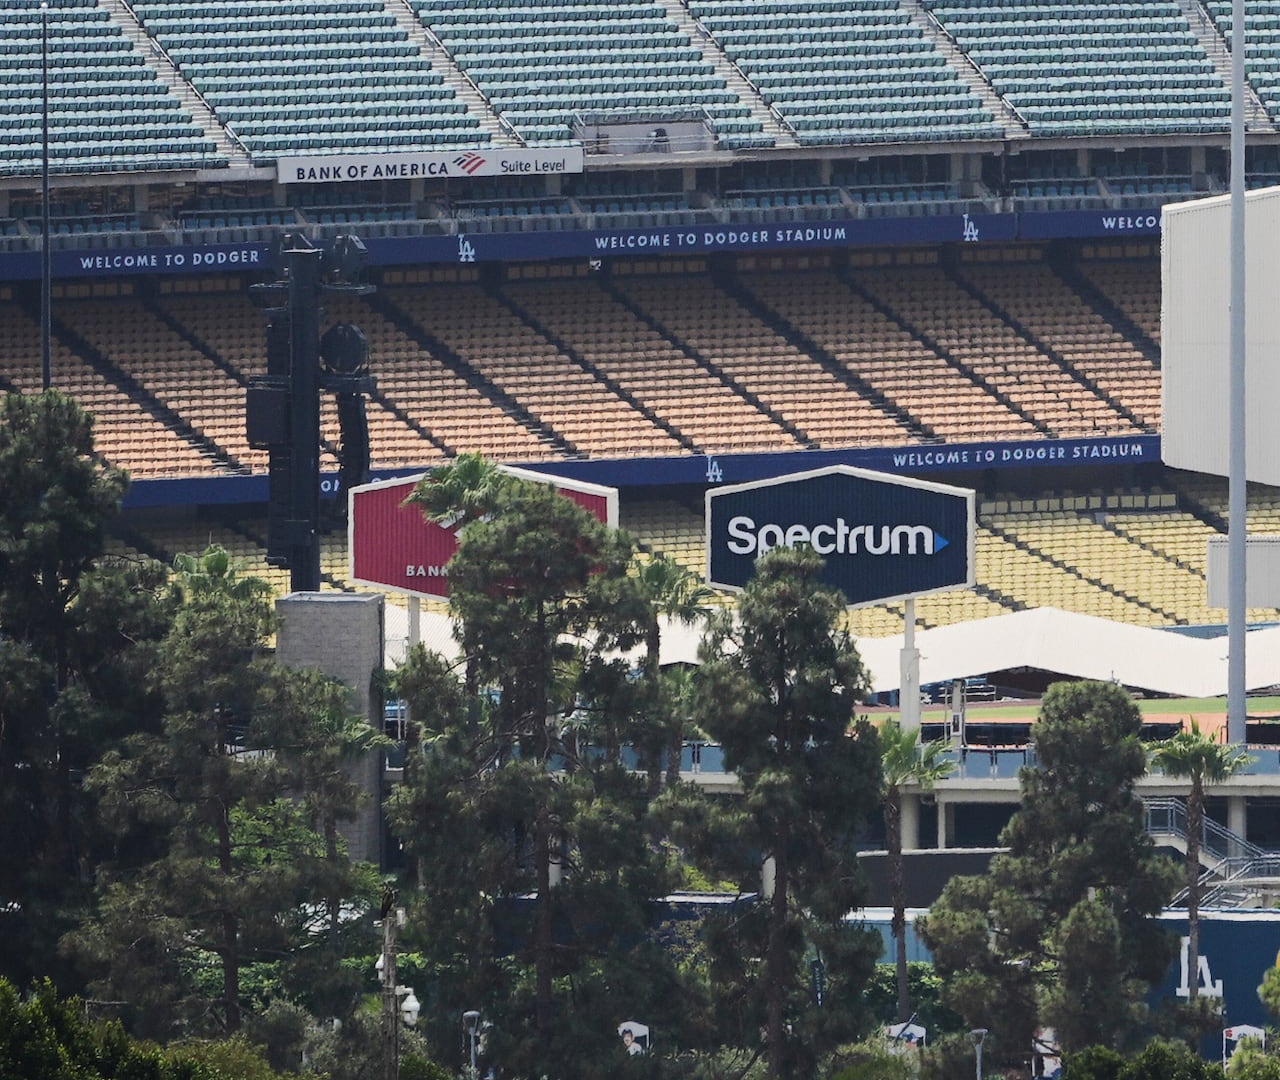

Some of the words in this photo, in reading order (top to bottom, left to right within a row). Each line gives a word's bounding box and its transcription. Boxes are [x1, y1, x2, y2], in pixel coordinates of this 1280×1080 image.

[296, 166, 341, 180] BANK
[347, 165, 368, 178] OF
[372, 162, 449, 177] AMERICA
[500, 159, 531, 172] Suite
[535, 159, 566, 172] Level
[962, 213, 979, 242] LA
[1102, 215, 1162, 230] WELCO
[457, 233, 476, 262] LA
[595, 233, 670, 249] WELCOME
[677, 233, 697, 247] TO
[704, 230, 769, 246] DODGER
[776, 227, 847, 242] STADIUM
[81, 253, 158, 269] WELCOME
[164, 253, 185, 267] TO
[192, 249, 260, 266] DODGER
[893, 450, 969, 467] WELCOME
[975, 449, 996, 463] TO
[1002, 446, 1066, 461] DODGER
[1072, 443, 1144, 458] STADIUM
[706, 455, 723, 482] LA
[727, 516, 934, 557] Spectrum
